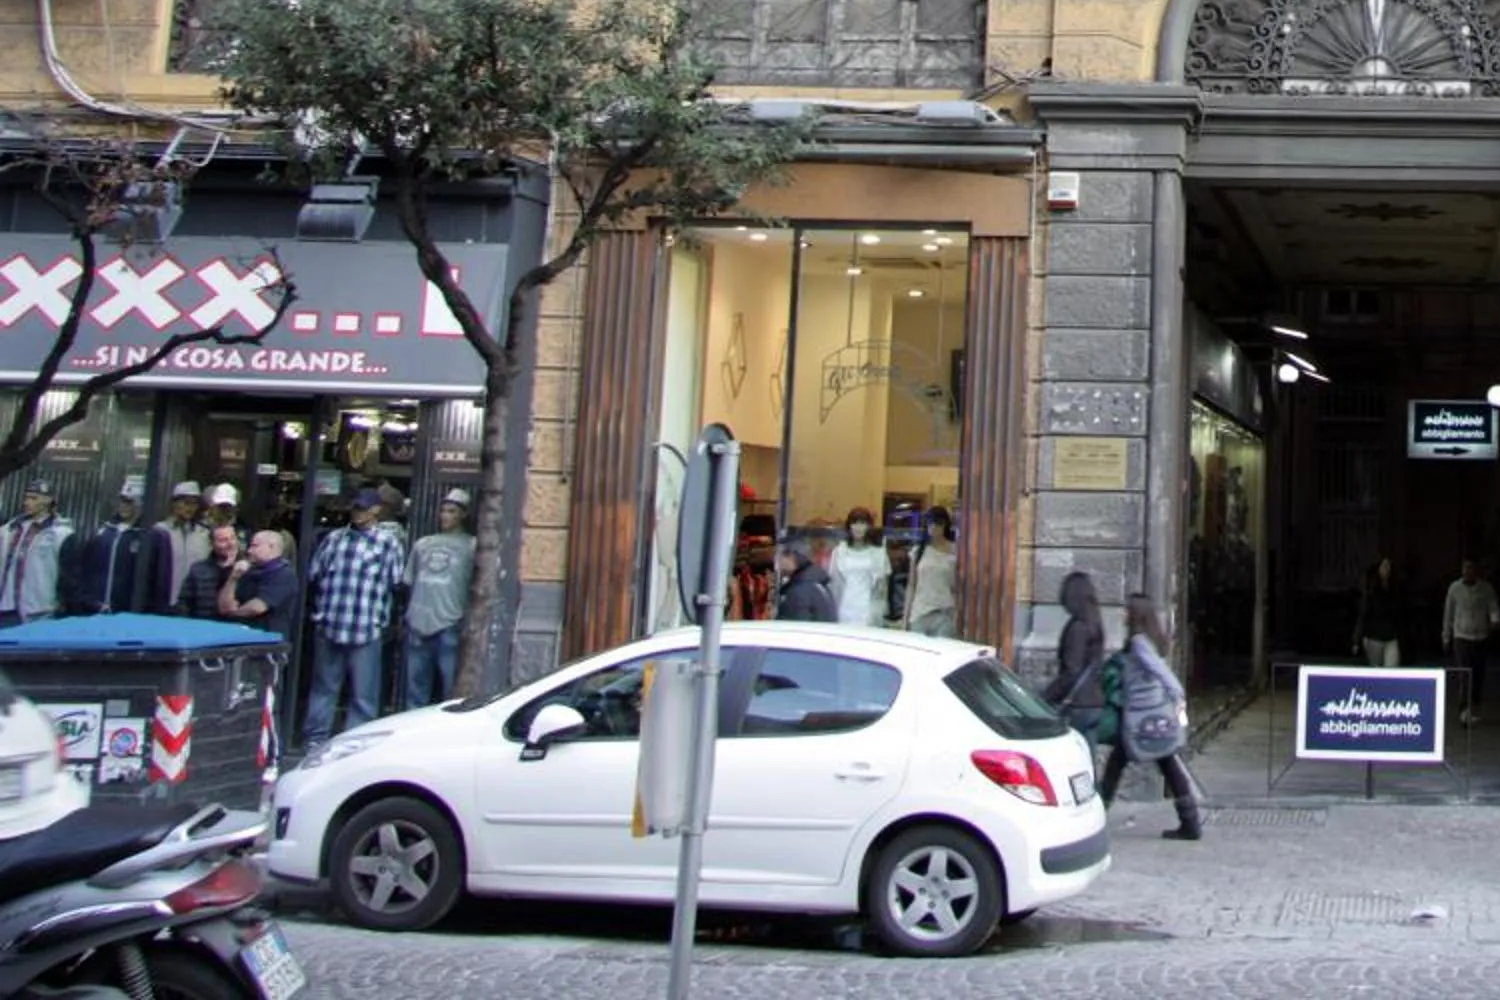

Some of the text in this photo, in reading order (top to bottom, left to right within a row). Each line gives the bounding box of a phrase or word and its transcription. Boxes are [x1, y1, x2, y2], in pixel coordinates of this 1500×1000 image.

[173, 348, 244, 369] COSA
[1421, 427, 1486, 440] abbigliamento
[1319, 720, 1422, 738] abbigliamento
